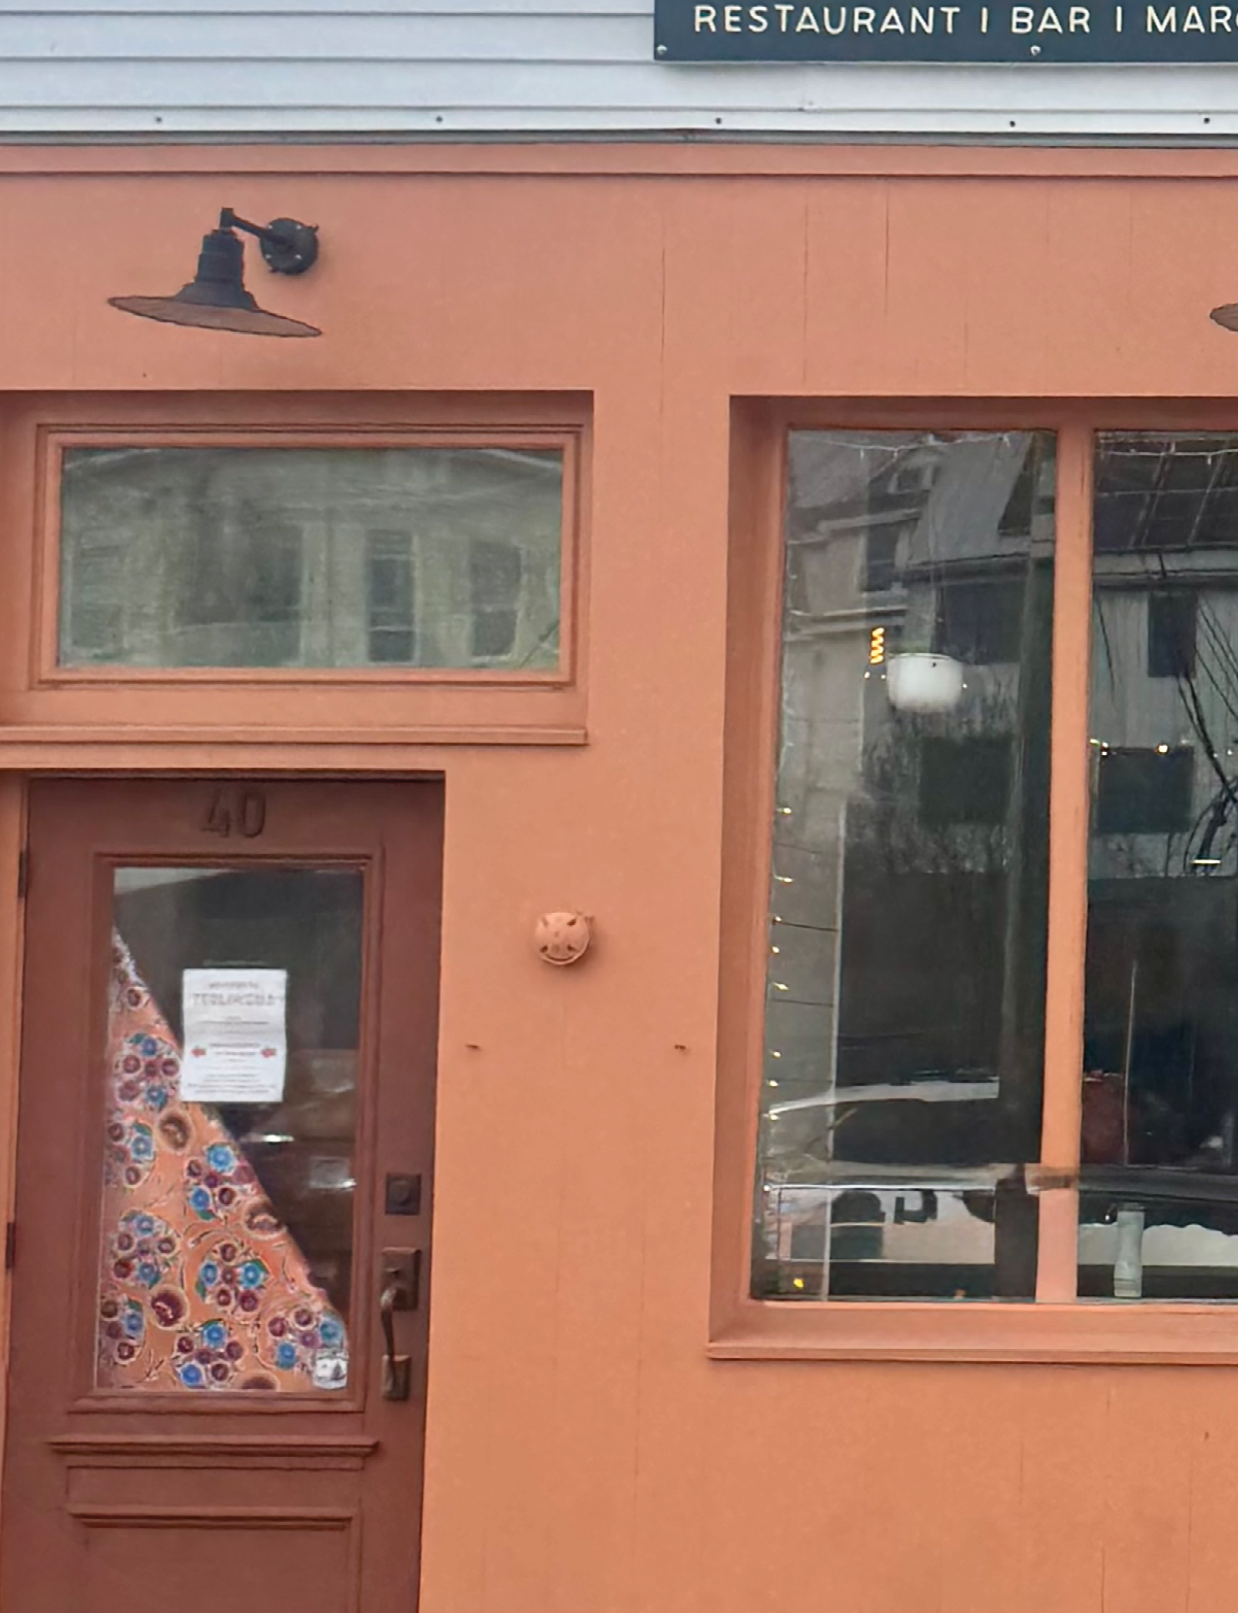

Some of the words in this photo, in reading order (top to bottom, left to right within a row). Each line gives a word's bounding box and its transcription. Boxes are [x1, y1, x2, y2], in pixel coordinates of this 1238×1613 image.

[694, 4, 961, 35] RESTAURANT
[1011, 6, 1090, 34] BAR
[200, 789, 266, 839] 40
